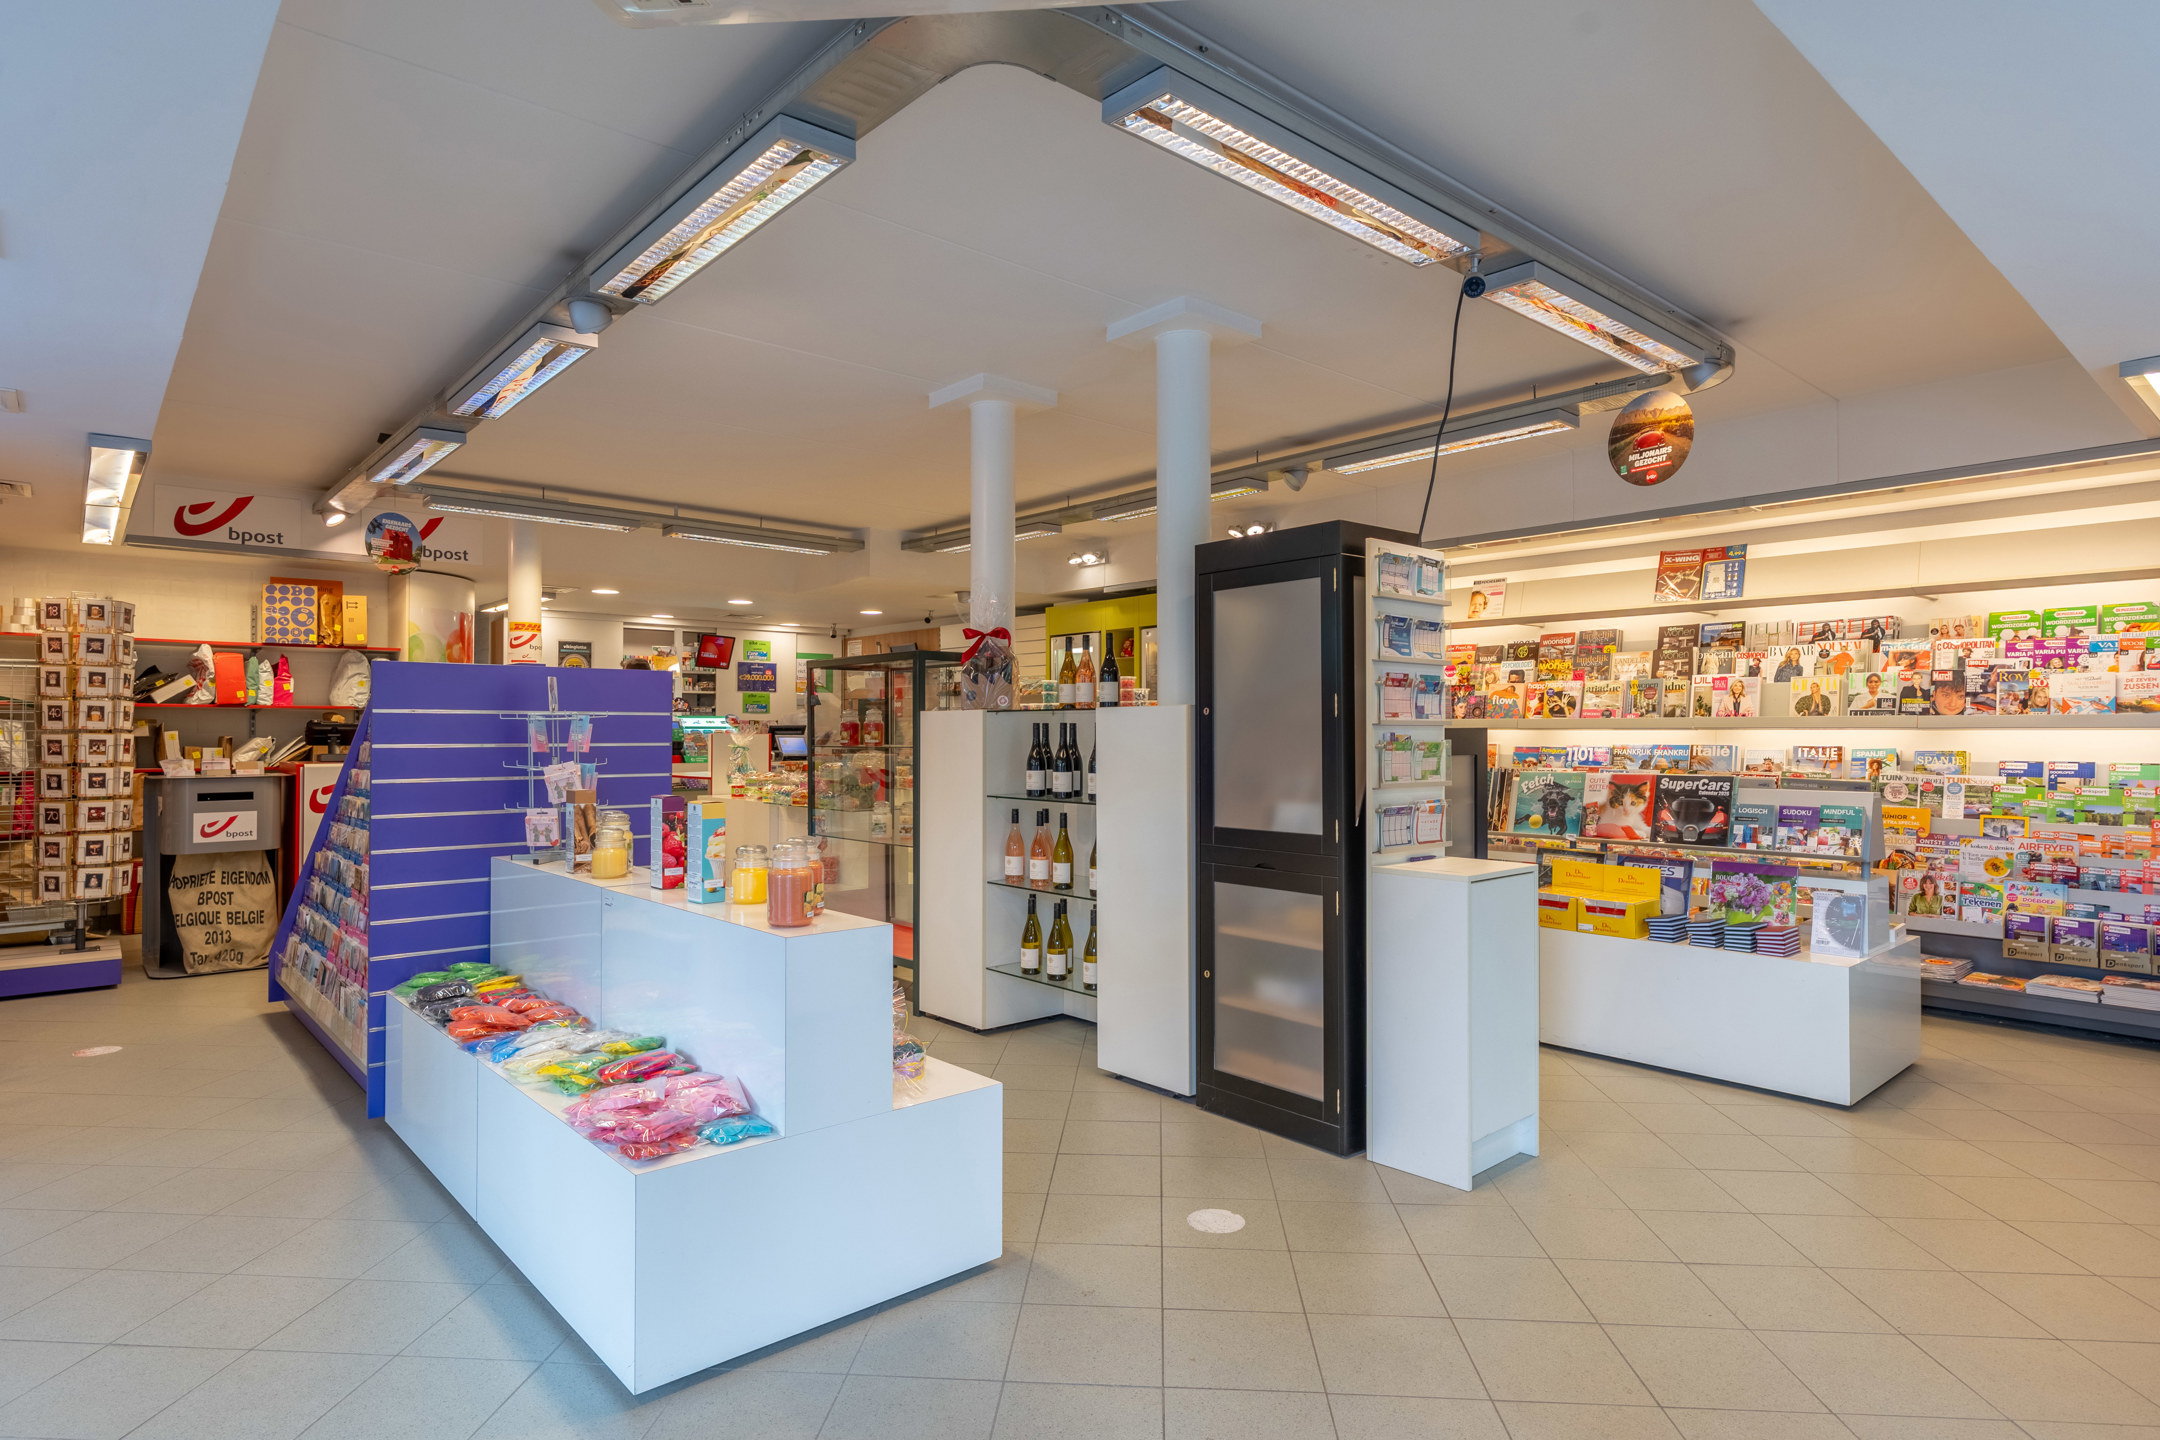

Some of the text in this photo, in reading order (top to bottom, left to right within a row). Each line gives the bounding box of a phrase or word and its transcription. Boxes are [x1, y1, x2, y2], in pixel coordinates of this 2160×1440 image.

[1629, 446, 1672, 462] MILJONAIRS
[1634, 454, 1668, 467] GEZOCHT
[228, 527, 284, 545] bpost
[423, 546, 469, 562] bpost
[1665, 555, 1699, 563] X-WING
[1942, 640, 1994, 650] COSMOPOLITAN
[1540, 662, 1572, 670] wonen
[1492, 695, 1514, 704] flow
[1693, 745, 1730, 757] Italië
[1798, 748, 1838, 758] ITALIE
[1917, 756, 1964, 766] SPANJE
[1520, 774, 1554, 794] Fetch
[1660, 778, 1730, 792] SuperCars
[47, 810, 60, 821] 70
[226, 830, 254, 839] bpost
[2018, 842, 2074, 852] AIRFRYER
[221, 870, 271, 886] EIGENDOM
[198, 892, 234, 906] BPOST
[226, 910, 265, 926] BELGIE
[205, 930, 232, 945] 2013
